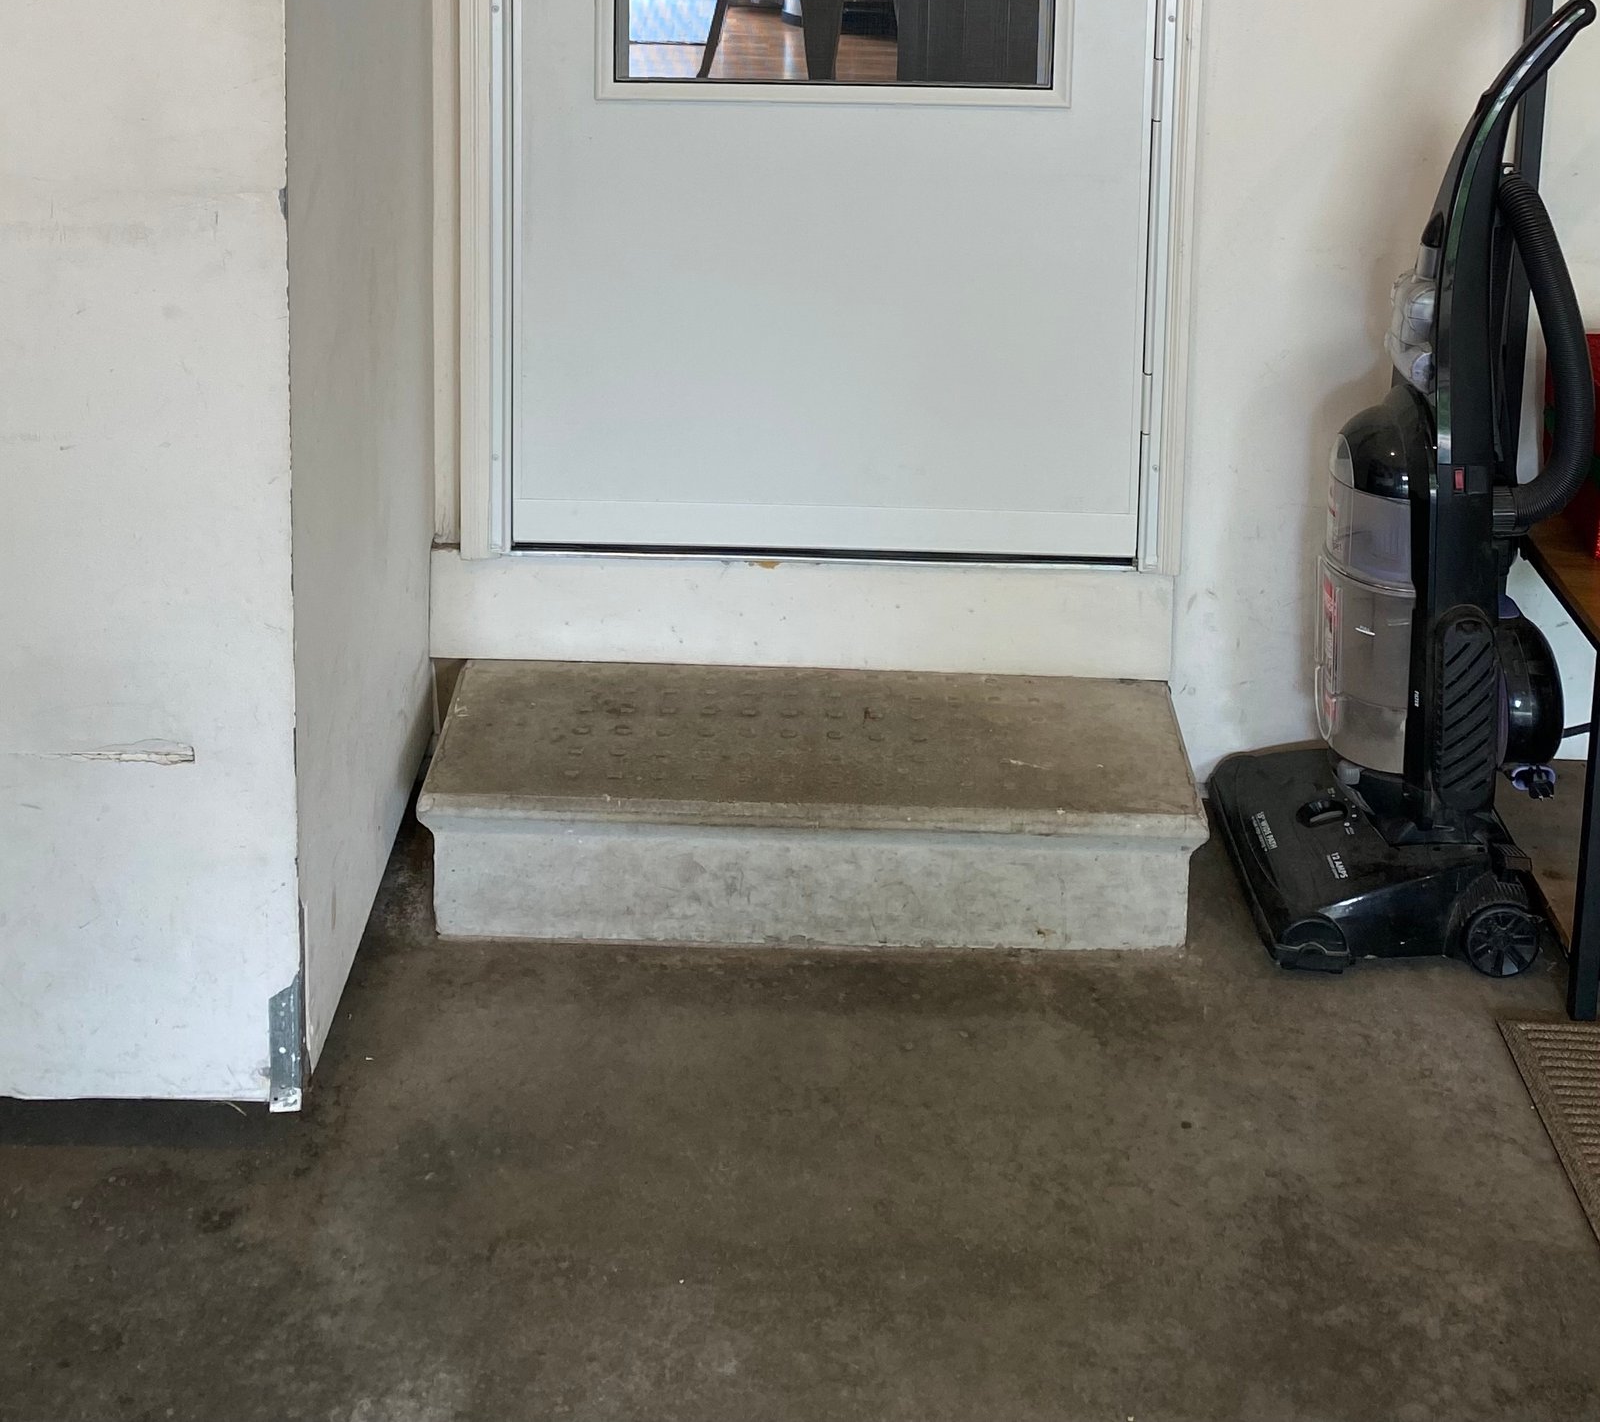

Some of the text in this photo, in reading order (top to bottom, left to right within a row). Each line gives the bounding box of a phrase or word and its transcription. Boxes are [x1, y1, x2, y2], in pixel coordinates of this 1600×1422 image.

[1265, 834, 1278, 850] PATH
[1331, 852, 1341, 860] 12
[1334, 860, 1349, 879] AMPS
